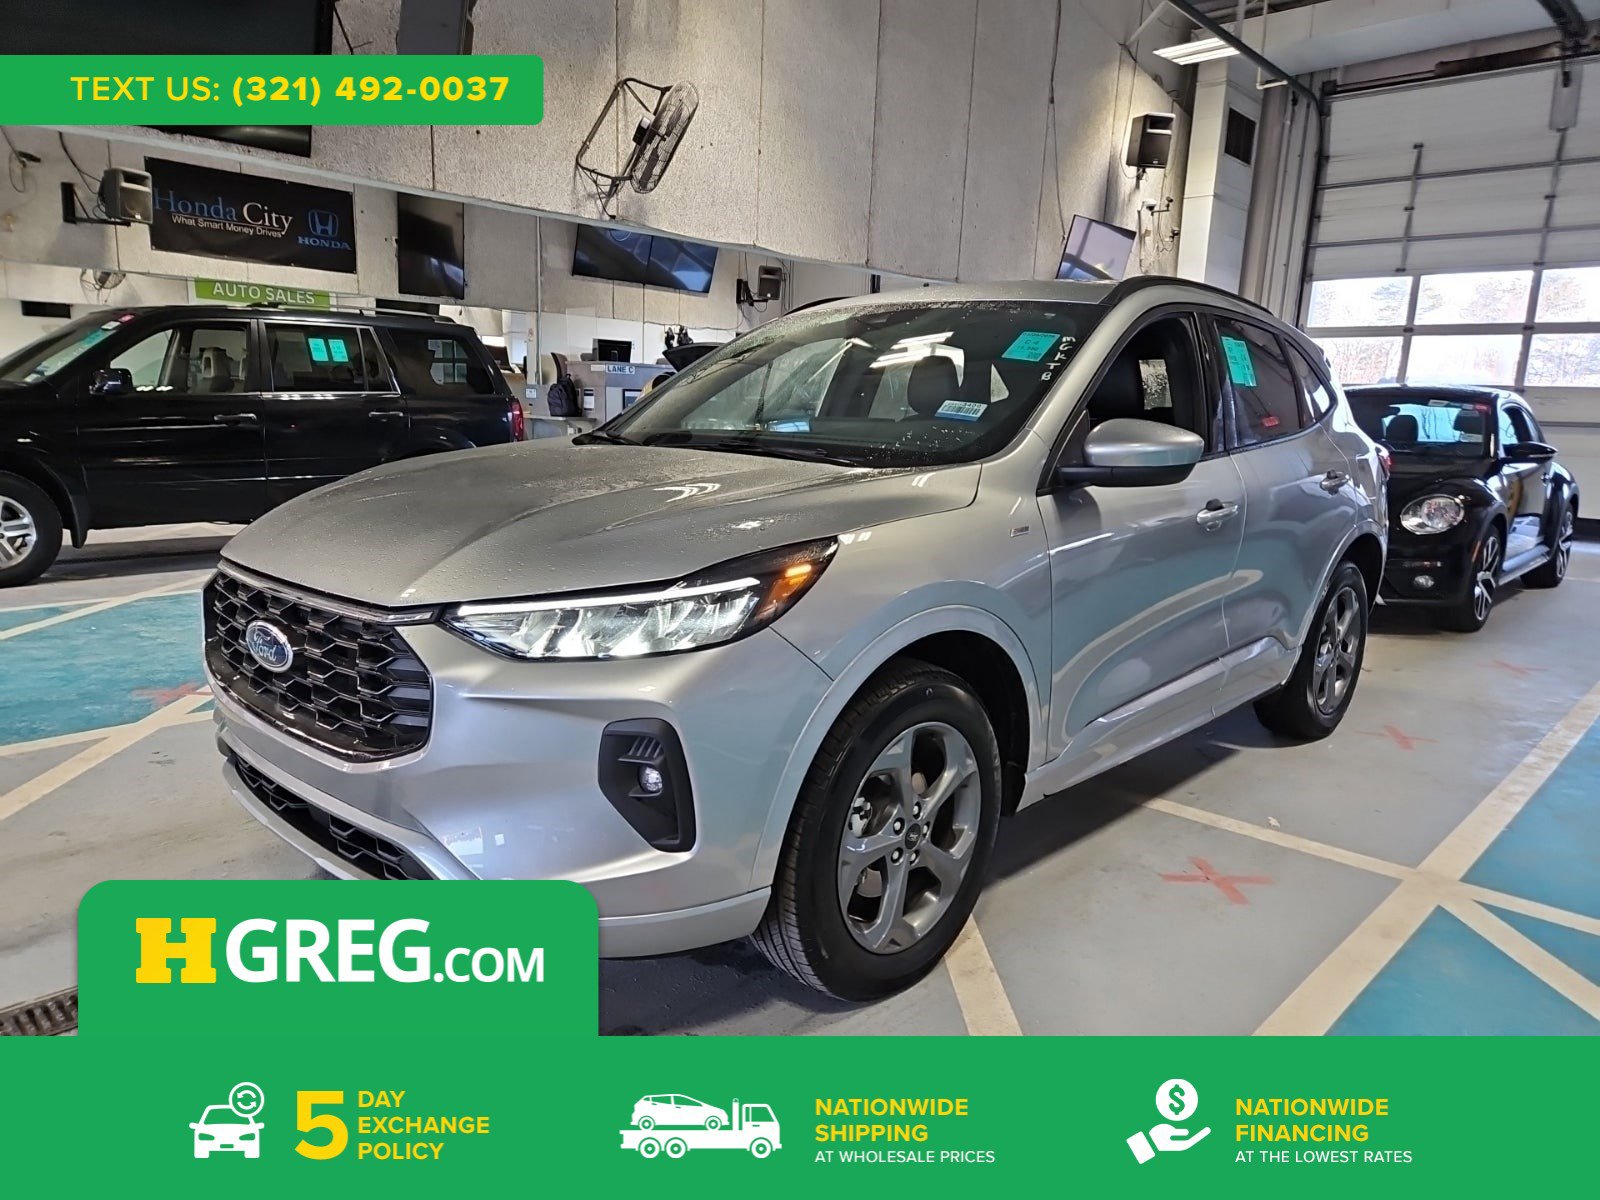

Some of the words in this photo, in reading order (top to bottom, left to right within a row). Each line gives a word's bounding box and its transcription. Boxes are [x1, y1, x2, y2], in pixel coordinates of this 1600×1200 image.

[154, 188, 238, 222] Honda
[243, 202, 293, 235] City
[172, 215, 196, 227] What
[199, 219, 224, 231] Smart
[226, 223, 254, 236] Money
[257, 227, 282, 239] Drives
[298, 236, 352, 251] HONDA
[213, 282, 261, 299] AUTO
[265, 287, 315, 304] SALES
[607, 365, 626, 373] LANE
[628, 366, 633, 374] C
[252, 630, 277, 661] Ford
